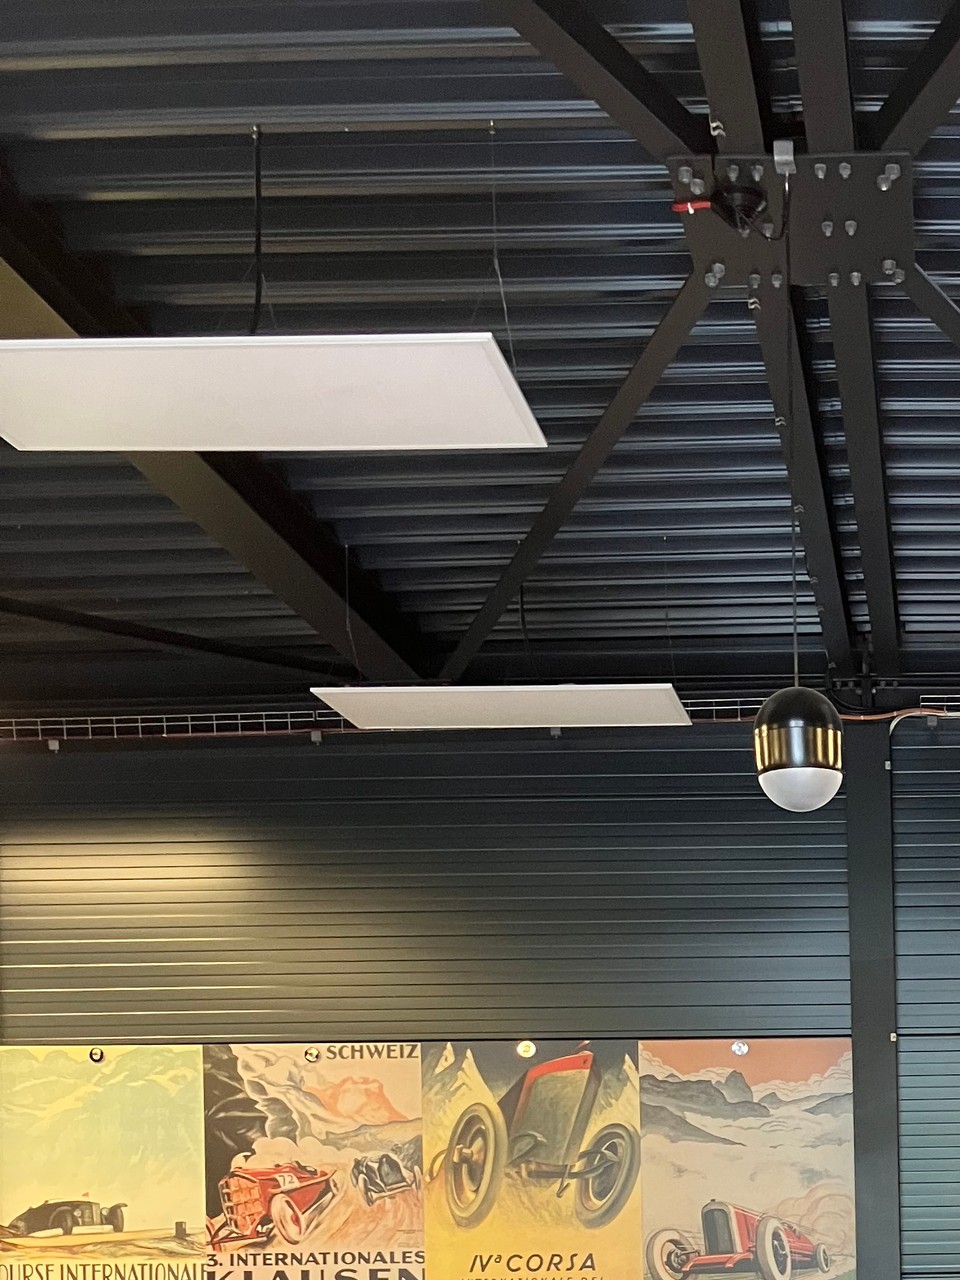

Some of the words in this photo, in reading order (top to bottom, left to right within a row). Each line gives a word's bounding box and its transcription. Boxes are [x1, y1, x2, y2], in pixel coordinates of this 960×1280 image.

[326, 1044, 419, 1059] SCHWEIZ
[278, 1174, 295, 1187] 72
[207, 1253, 223, 1267] 3.
[229, 1250, 425, 1266] INTERNATIONALES
[506, 1253, 596, 1272] CORSA
